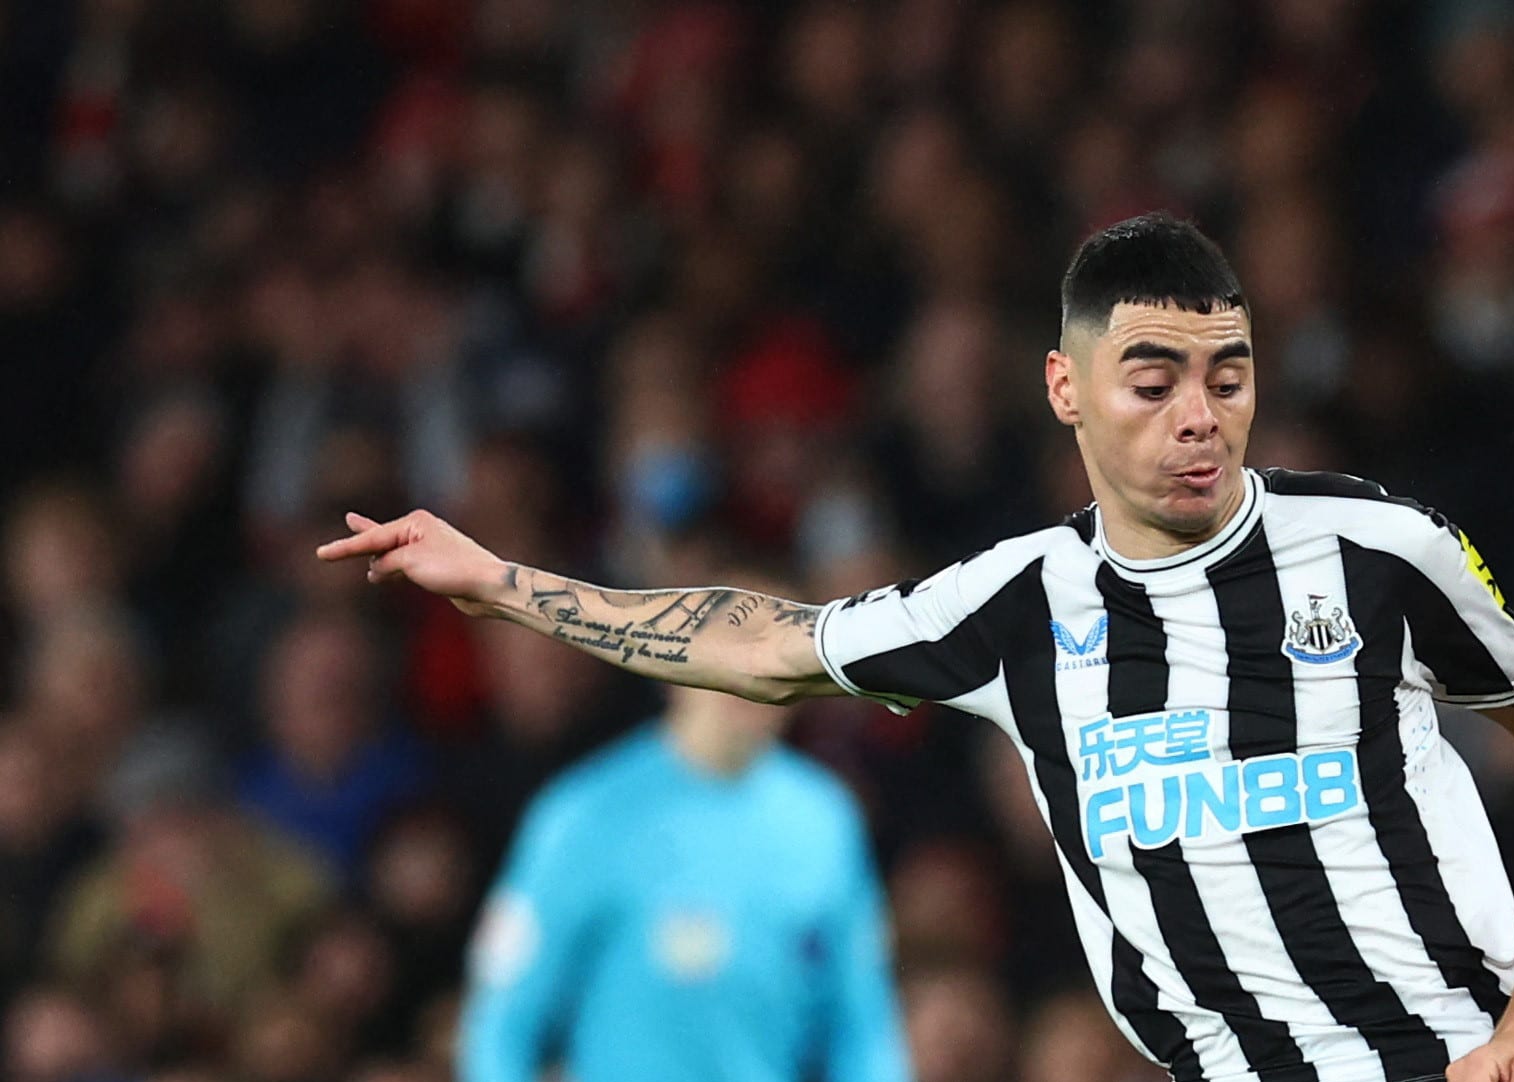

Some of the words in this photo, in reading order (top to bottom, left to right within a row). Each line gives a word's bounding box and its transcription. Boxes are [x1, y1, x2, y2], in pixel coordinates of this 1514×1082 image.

[1056, 657, 1110, 672] CASTORE
[1079, 709, 1211, 783] 乐天堂
[1086, 749, 1359, 860] FUN88
